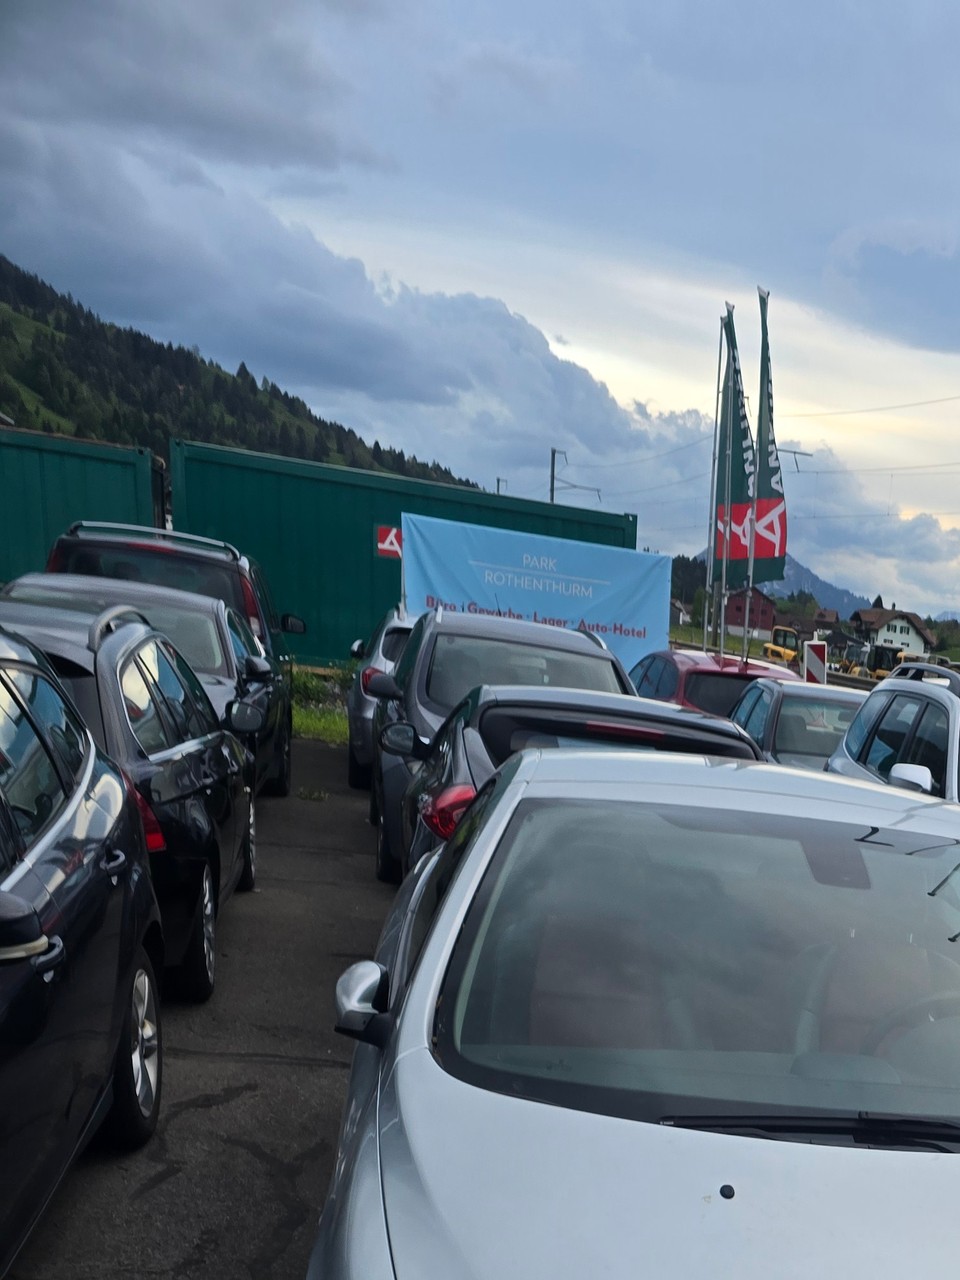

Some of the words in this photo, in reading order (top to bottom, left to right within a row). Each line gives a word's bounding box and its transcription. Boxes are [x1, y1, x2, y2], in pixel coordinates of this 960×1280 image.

[522, 554, 557, 571] PARK
[485, 571, 592, 598] ROTHENTHURM
[533, 611, 568, 628] Lager
[578, 618, 646, 638] Auto-Hotel
